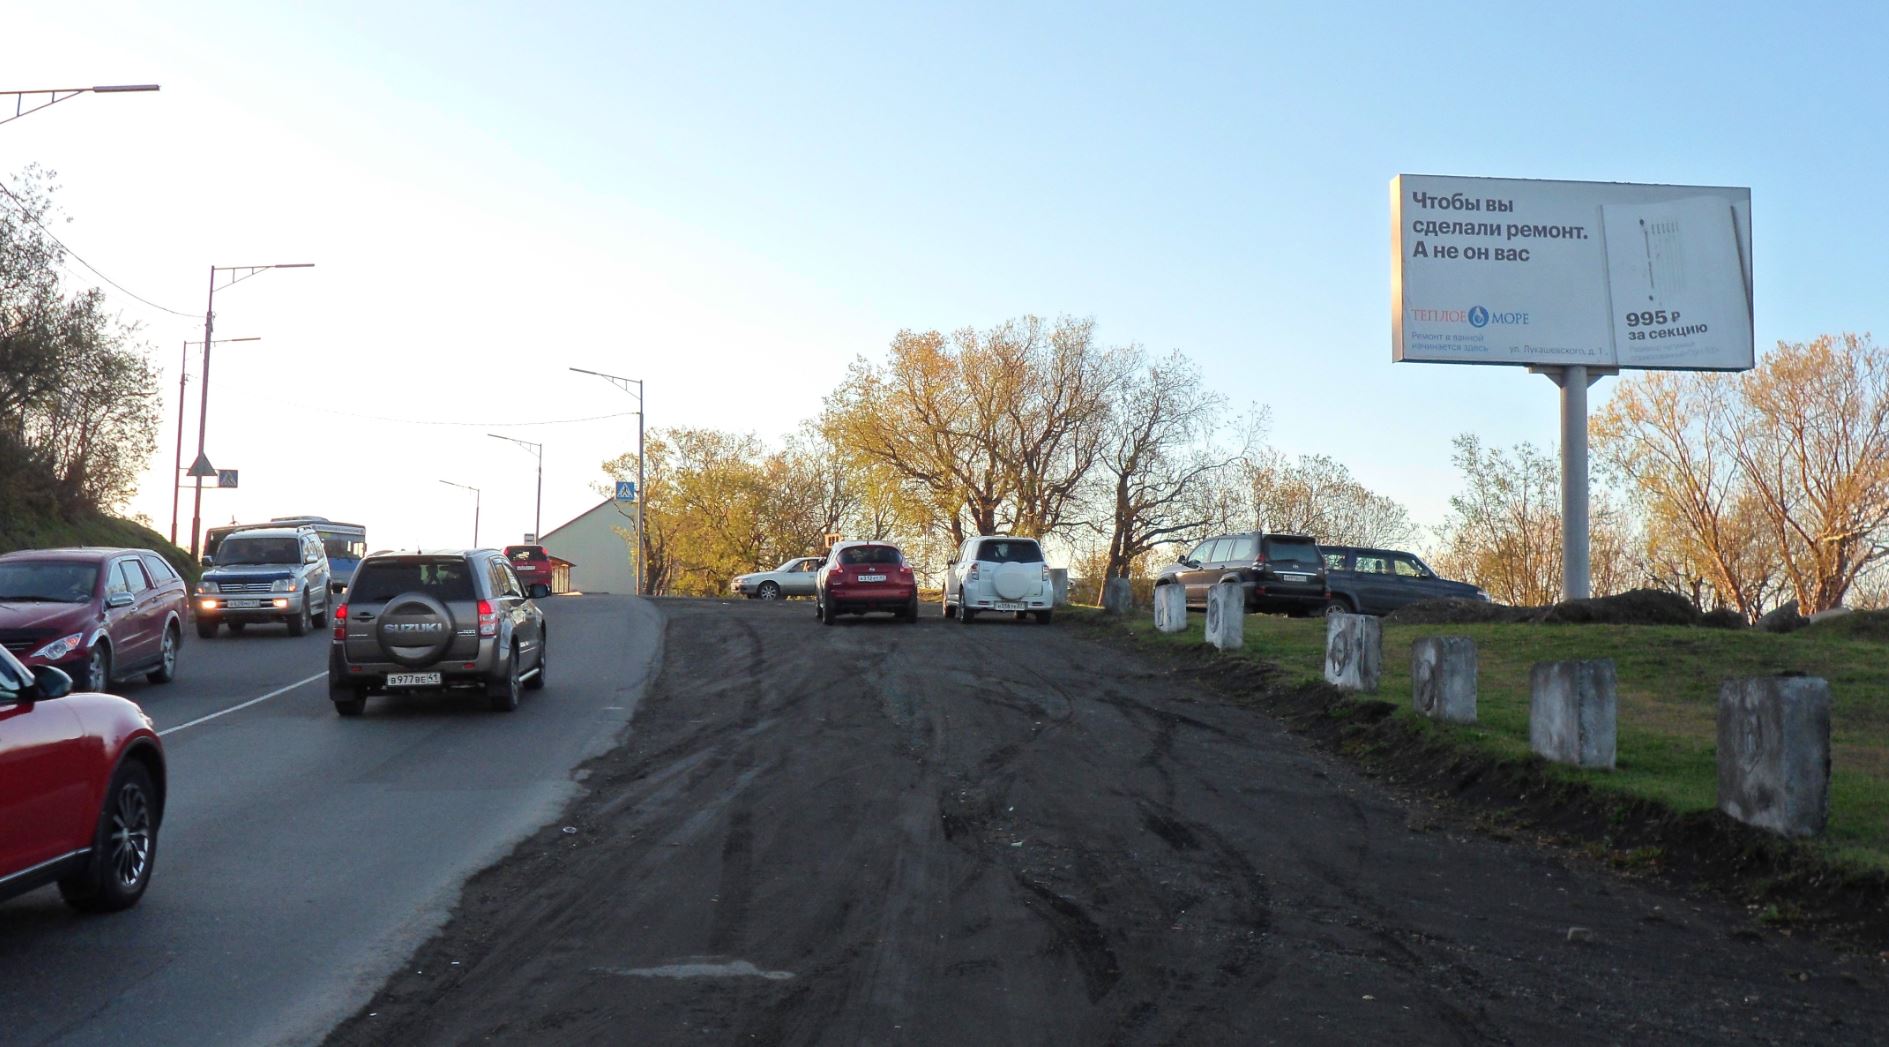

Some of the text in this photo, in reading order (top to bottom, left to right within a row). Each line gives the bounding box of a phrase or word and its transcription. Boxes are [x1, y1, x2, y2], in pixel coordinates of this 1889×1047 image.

[1412, 191, 1514, 213] Чтобы вы
[1412, 220, 1589, 241] сделали ремонт.
[1412, 240, 1531, 262] А не он вас
[1410, 308, 1529, 325] ТЕПЛОЕ МОРЕ
[1626, 310, 1668, 327] 995
[1628, 323, 1708, 341] за секцию
[383, 622, 443, 634] SUZUKI
